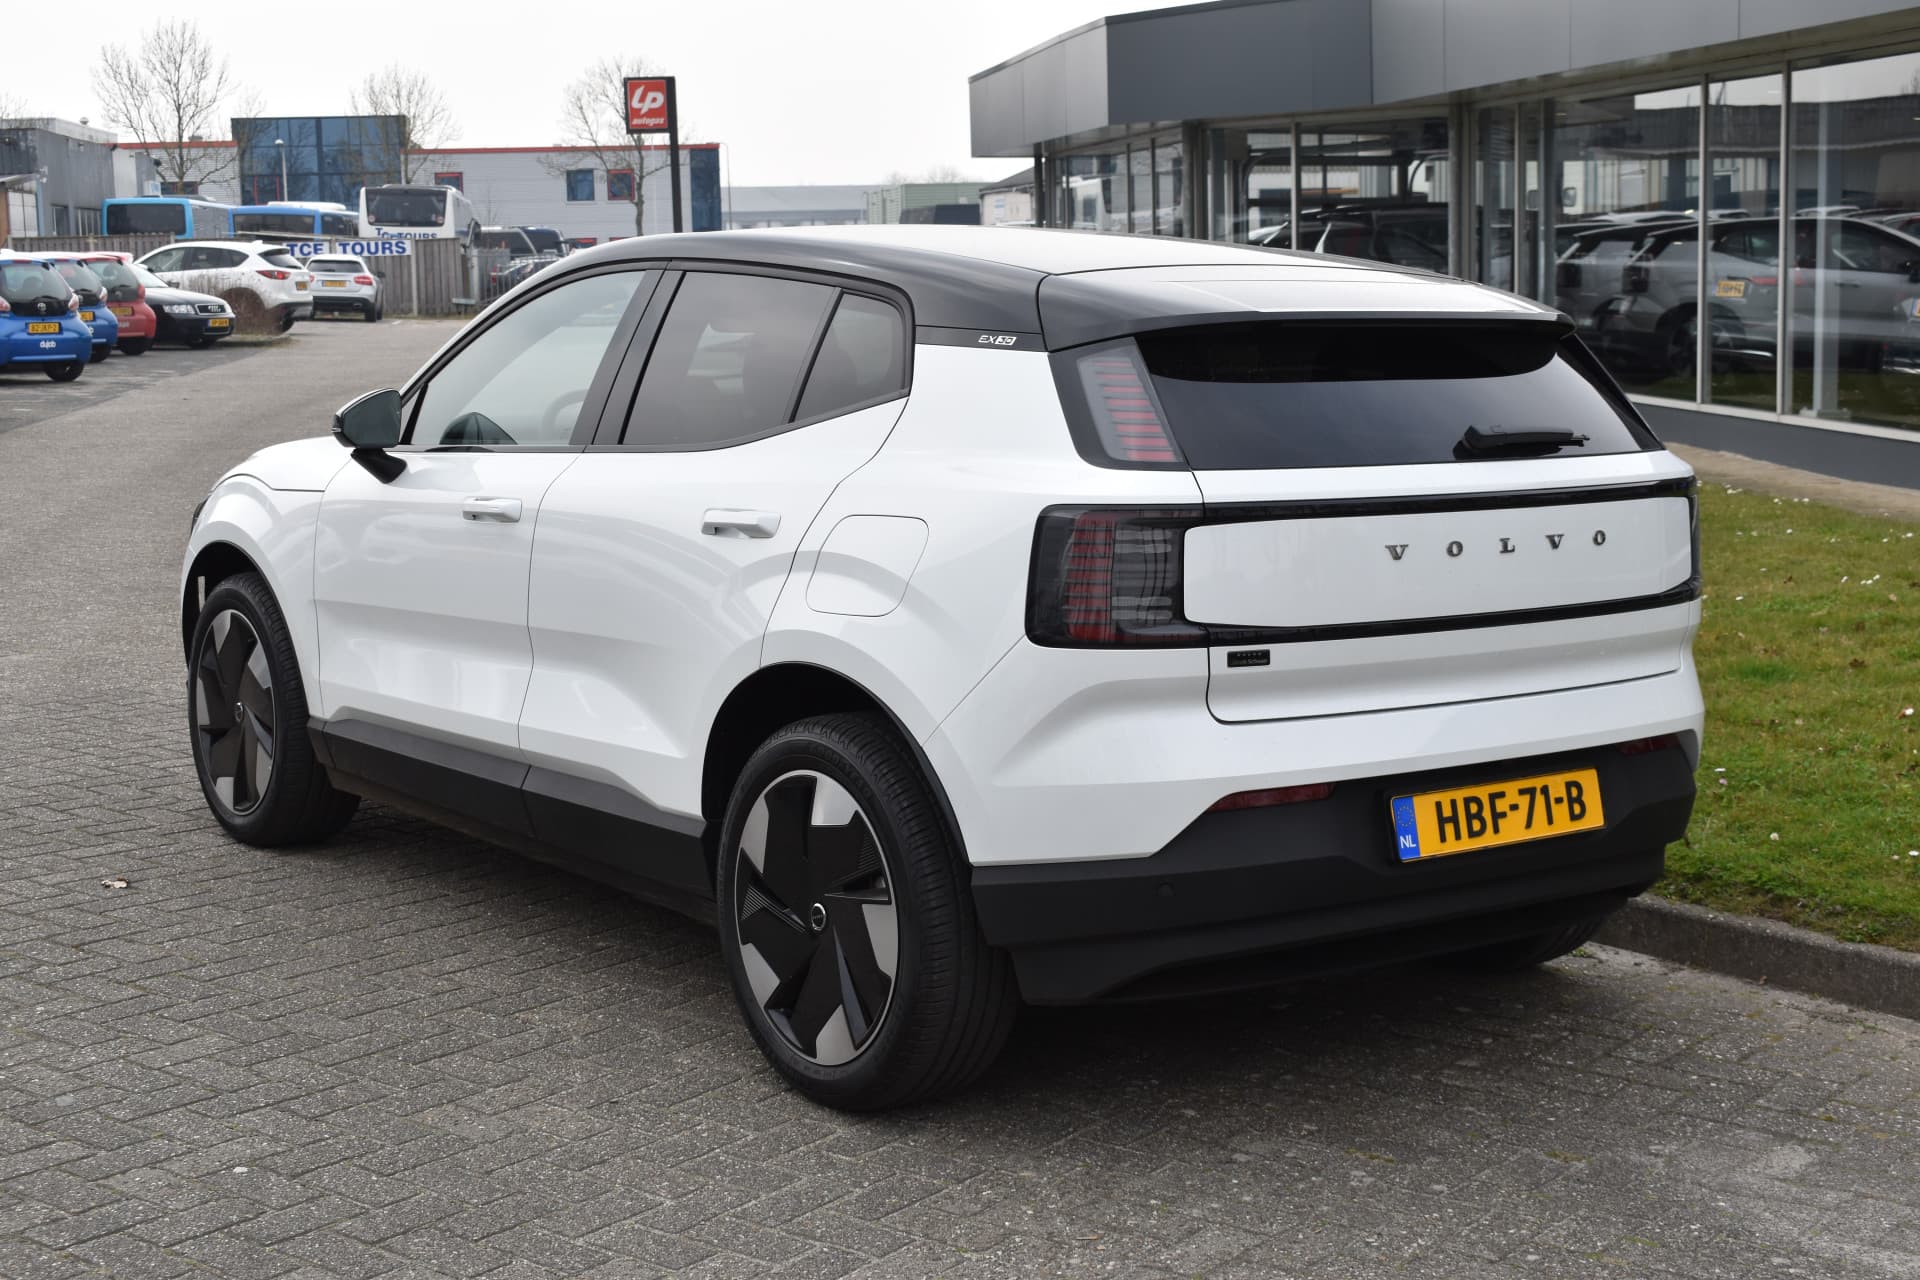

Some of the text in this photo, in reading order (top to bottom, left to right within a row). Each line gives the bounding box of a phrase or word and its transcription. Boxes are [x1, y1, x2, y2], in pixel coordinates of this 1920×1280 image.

[286, 241, 407, 256] TCE TOURS
[978, 335, 1017, 346] EX30
[1385, 530, 1606, 561] VOLVO
[1400, 780, 1587, 849] NL HBF-71-B
